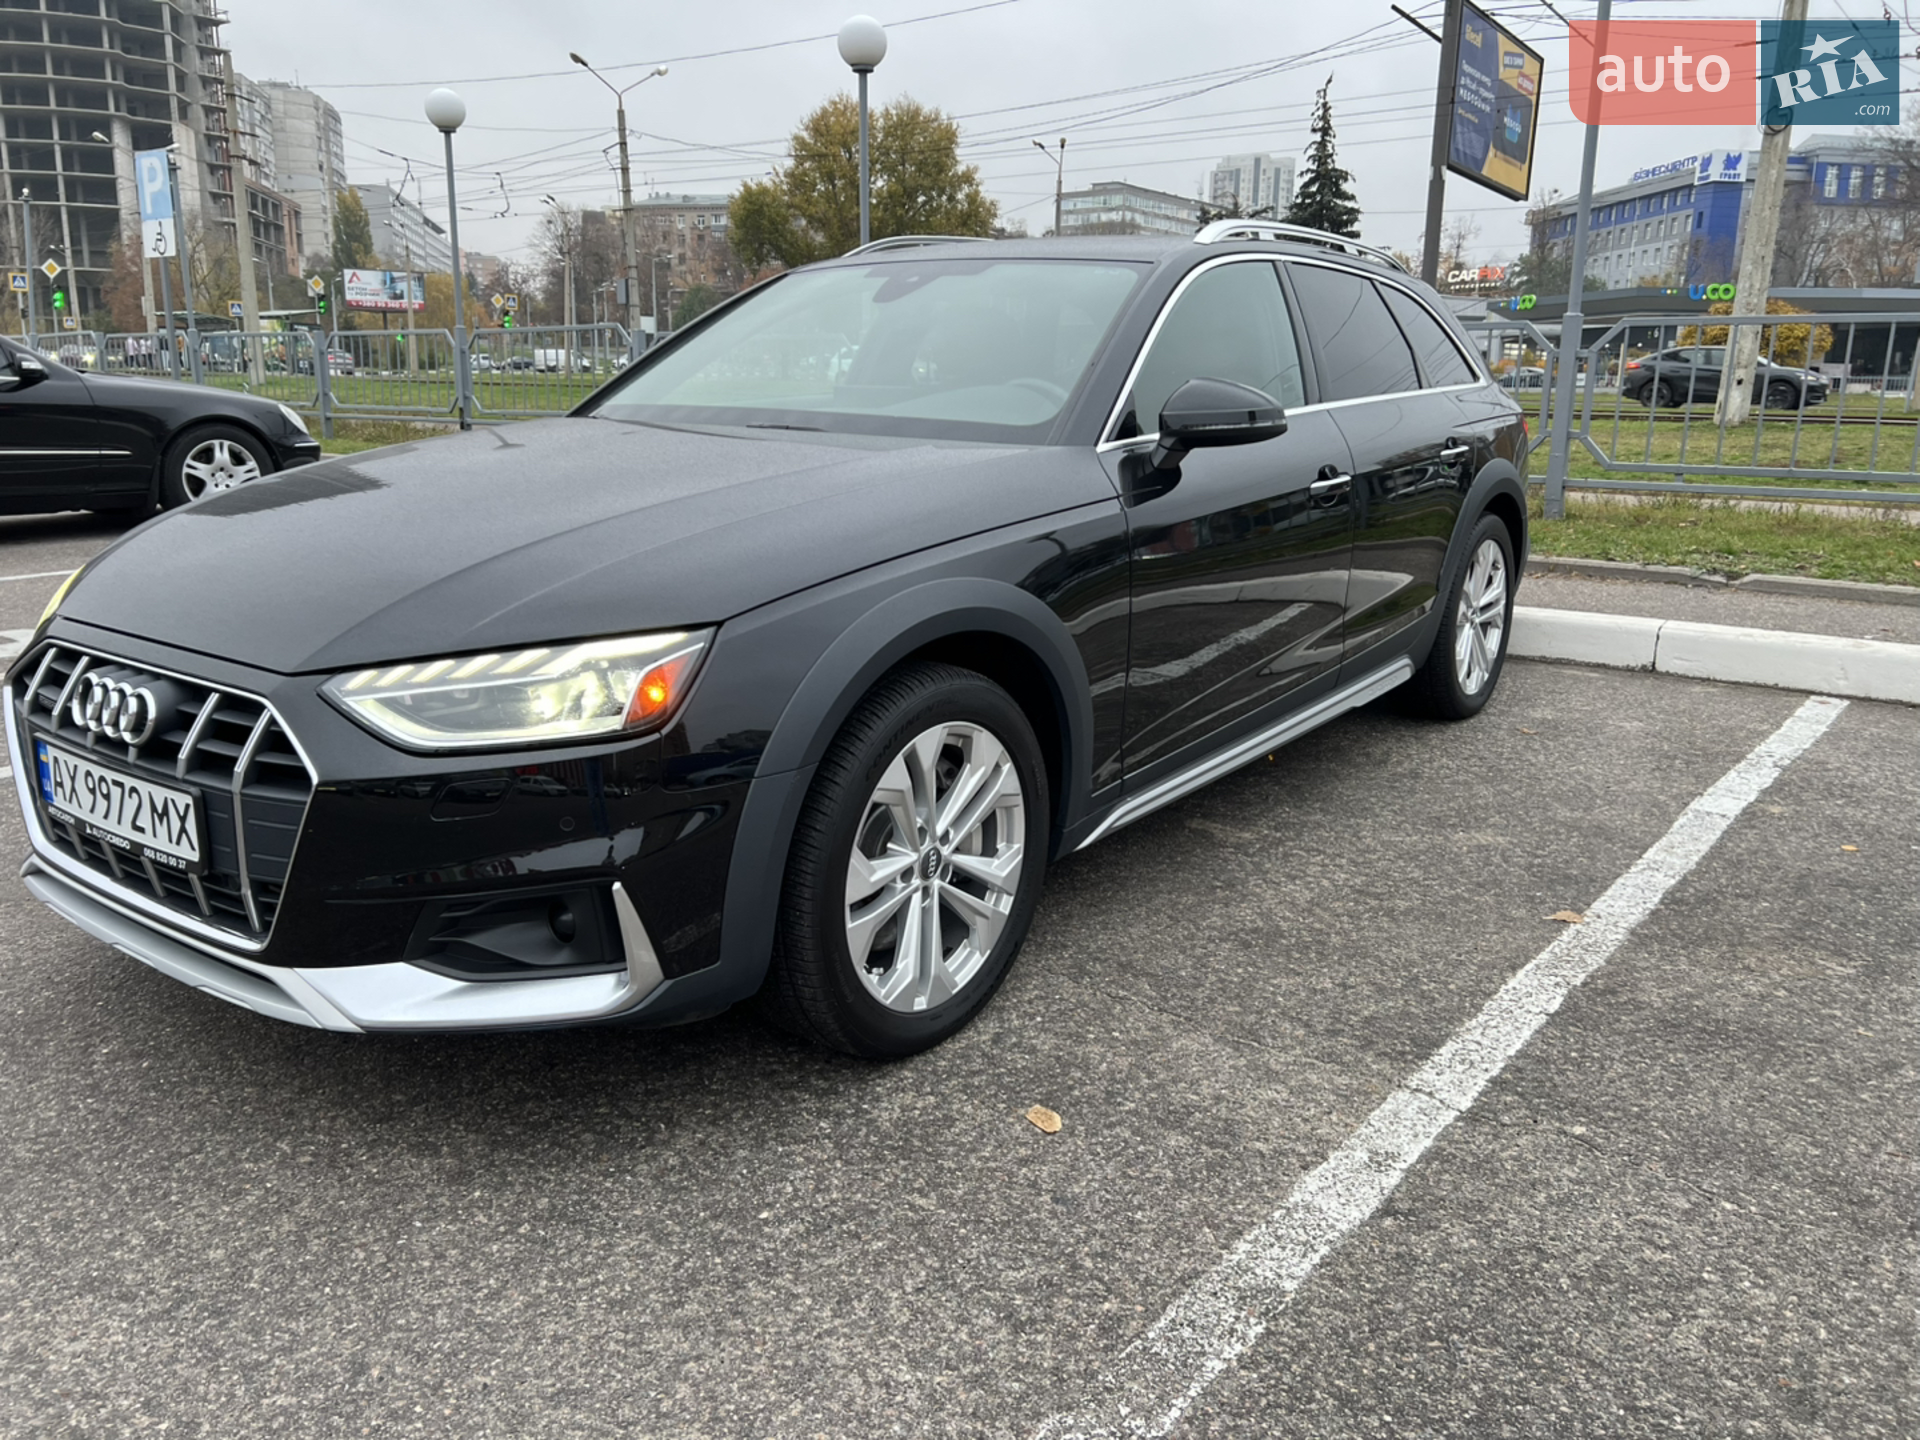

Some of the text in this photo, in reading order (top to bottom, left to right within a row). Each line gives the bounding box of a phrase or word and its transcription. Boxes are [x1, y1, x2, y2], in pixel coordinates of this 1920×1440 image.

[53, 755, 197, 852] AX 9972 MX
